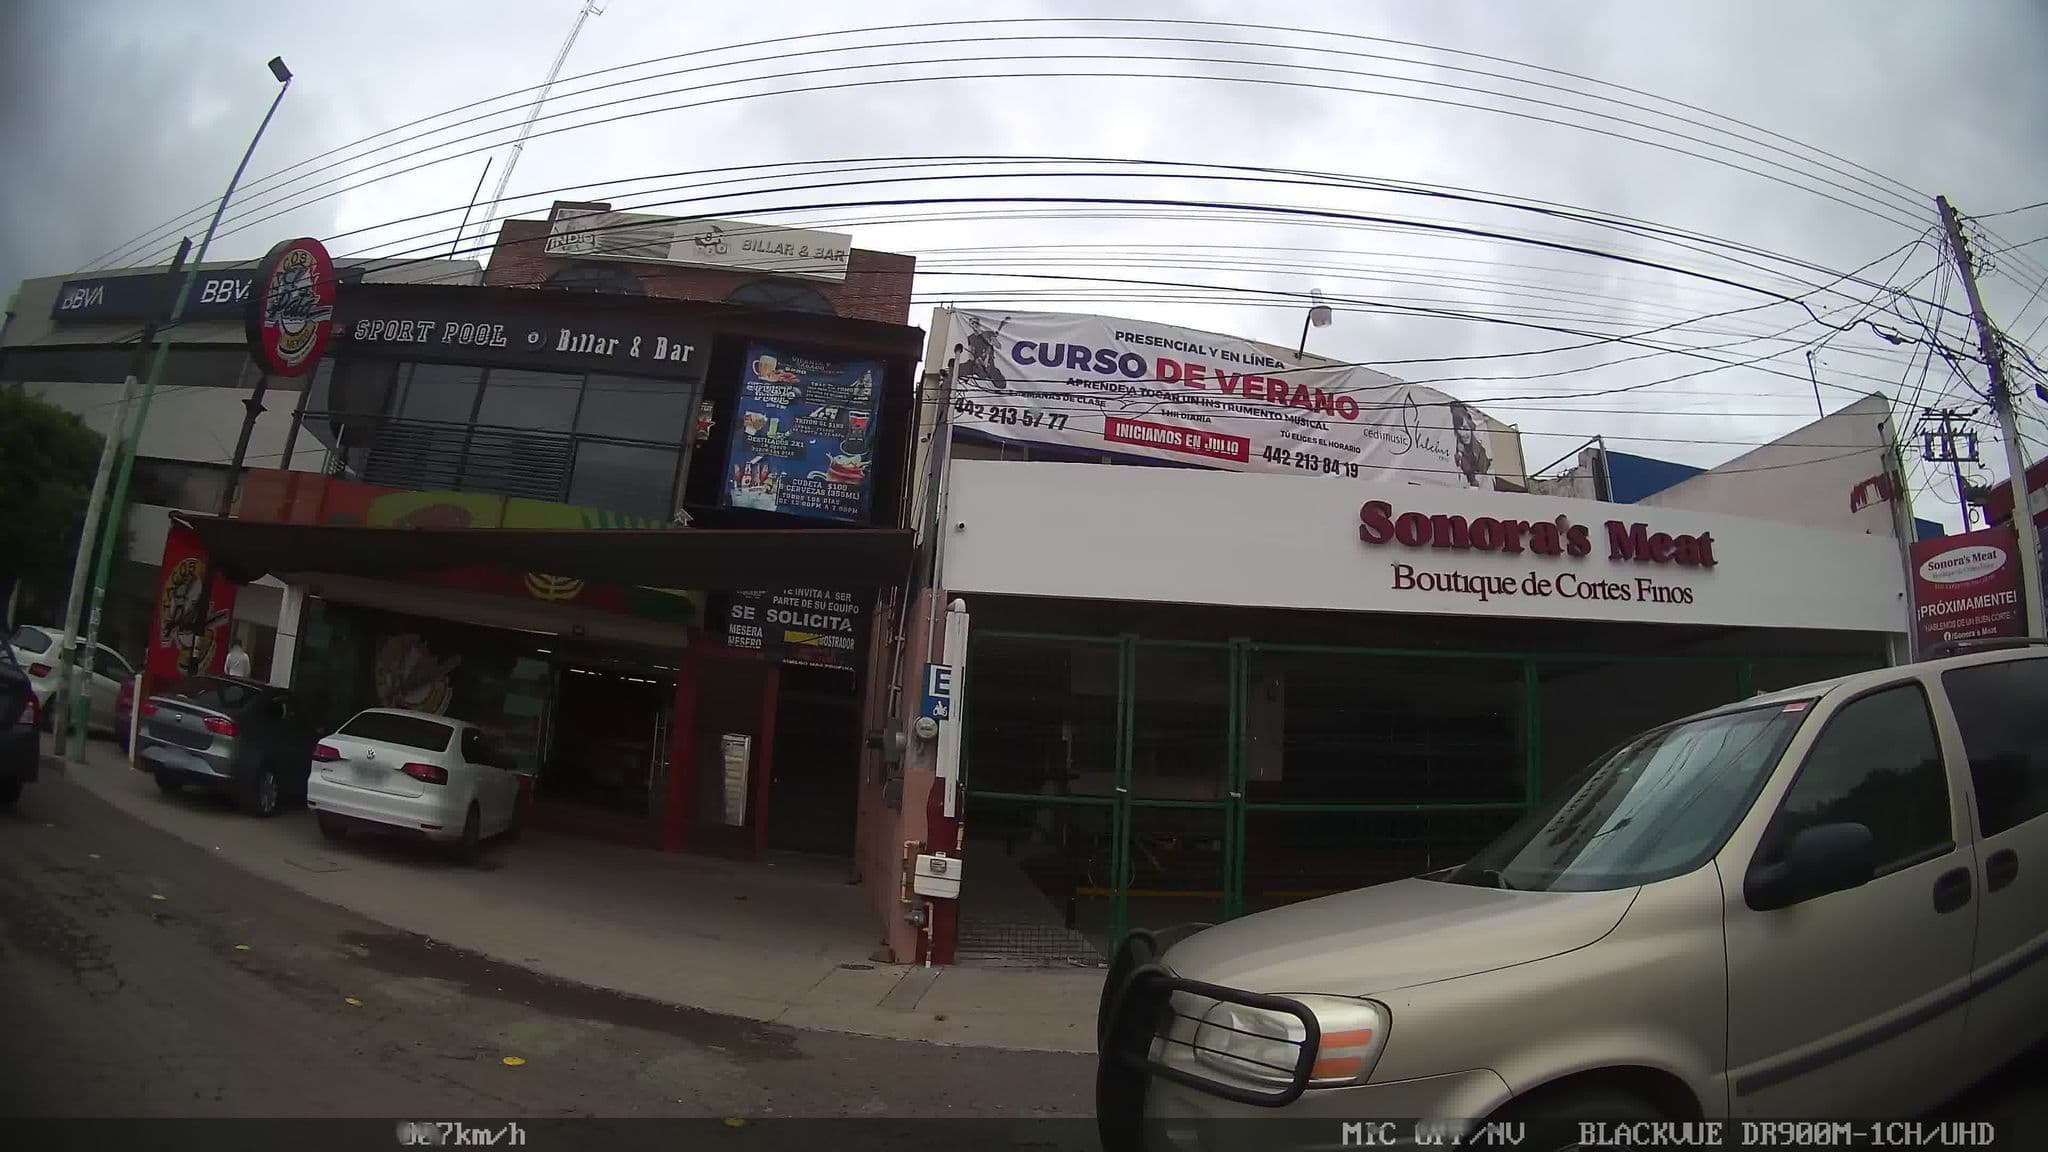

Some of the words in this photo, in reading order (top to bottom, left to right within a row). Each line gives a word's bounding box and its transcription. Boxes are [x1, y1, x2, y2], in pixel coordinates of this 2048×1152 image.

[742, 240, 795, 256] BILLAR
[799, 246, 808, 258] &
[813, 249, 845, 262] BAR
[200, 279, 251, 304] BBV
[354, 320, 435, 343] SPORT
[442, 322, 507, 347] POOL
[556, 328, 619, 355] Billar
[630, 336, 640, 358] &
[653, 337, 695, 362] Bar
[1115, 331, 1206, 355] PRESENCIAL
[1209, 347, 1218, 357] Y
[1221, 350, 1240, 362] EN
[1243, 352, 1285, 369] LÍNEA
[1011, 340, 1147, 379] CURSO
[1156, 357, 1206, 390] DE
[1215, 369, 1360, 420] VERANO
[1066, 377, 1126, 392] APRENDE
[1201, 398, 1282, 420] INSTRUMENTO
[1285, 413, 1329, 431] MUSICAL
[1077, 397, 1107, 407] CLASE
[989, 406, 1017, 425] 213
[1047, 413, 1069, 431] 77
[1116, 422, 1182, 446] INICIAMOS
[1186, 433, 1201, 449] EN
[1204, 437, 1239, 455] JULIO
[1292, 432, 1317, 444] ELIGES
[1318, 438, 1327, 447] EL
[1328, 441, 1361, 454] HORARIO
[1262, 445, 1291, 466] 442
[1295, 452, 1319, 471] 213
[1323, 457, 1340, 475] 84
[1344, 462, 1359, 478] 19
[786, 485, 826, 496] CERVEZAS
[793, 479, 822, 488] CUBETA
[1360, 500, 1592, 556] Sonora's
[1604, 520, 1719, 567] Meat
[1928, 555, 1970, 571] Sonora's
[1972, 550, 1997, 563] Meat
[795, 587, 822, 600] INVITA
[824, 591, 831, 599] A
[835, 592, 851, 602] SER
[1391, 563, 1517, 601] Boutique
[1521, 572, 1551, 597] de
[1555, 573, 1631, 601] Cortes
[1635, 578, 1694, 604] Finos
[773, 596, 800, 607] PARTE
[801, 599, 812, 608] DE
[815, 601, 826, 610] SU
[828, 602, 859, 614] EQUIPO
[1917, 590, 2017, 621] ¡PRÓXIMAMENTE!
[729, 623, 763, 638] MESERA
[731, 604, 756, 620] SE
[766, 608, 853, 632] SOLICITA
[728, 635, 762, 649] MESERO
[820, 633, 855, 650] OSTRADOR
[932, 667, 952, 697] E
